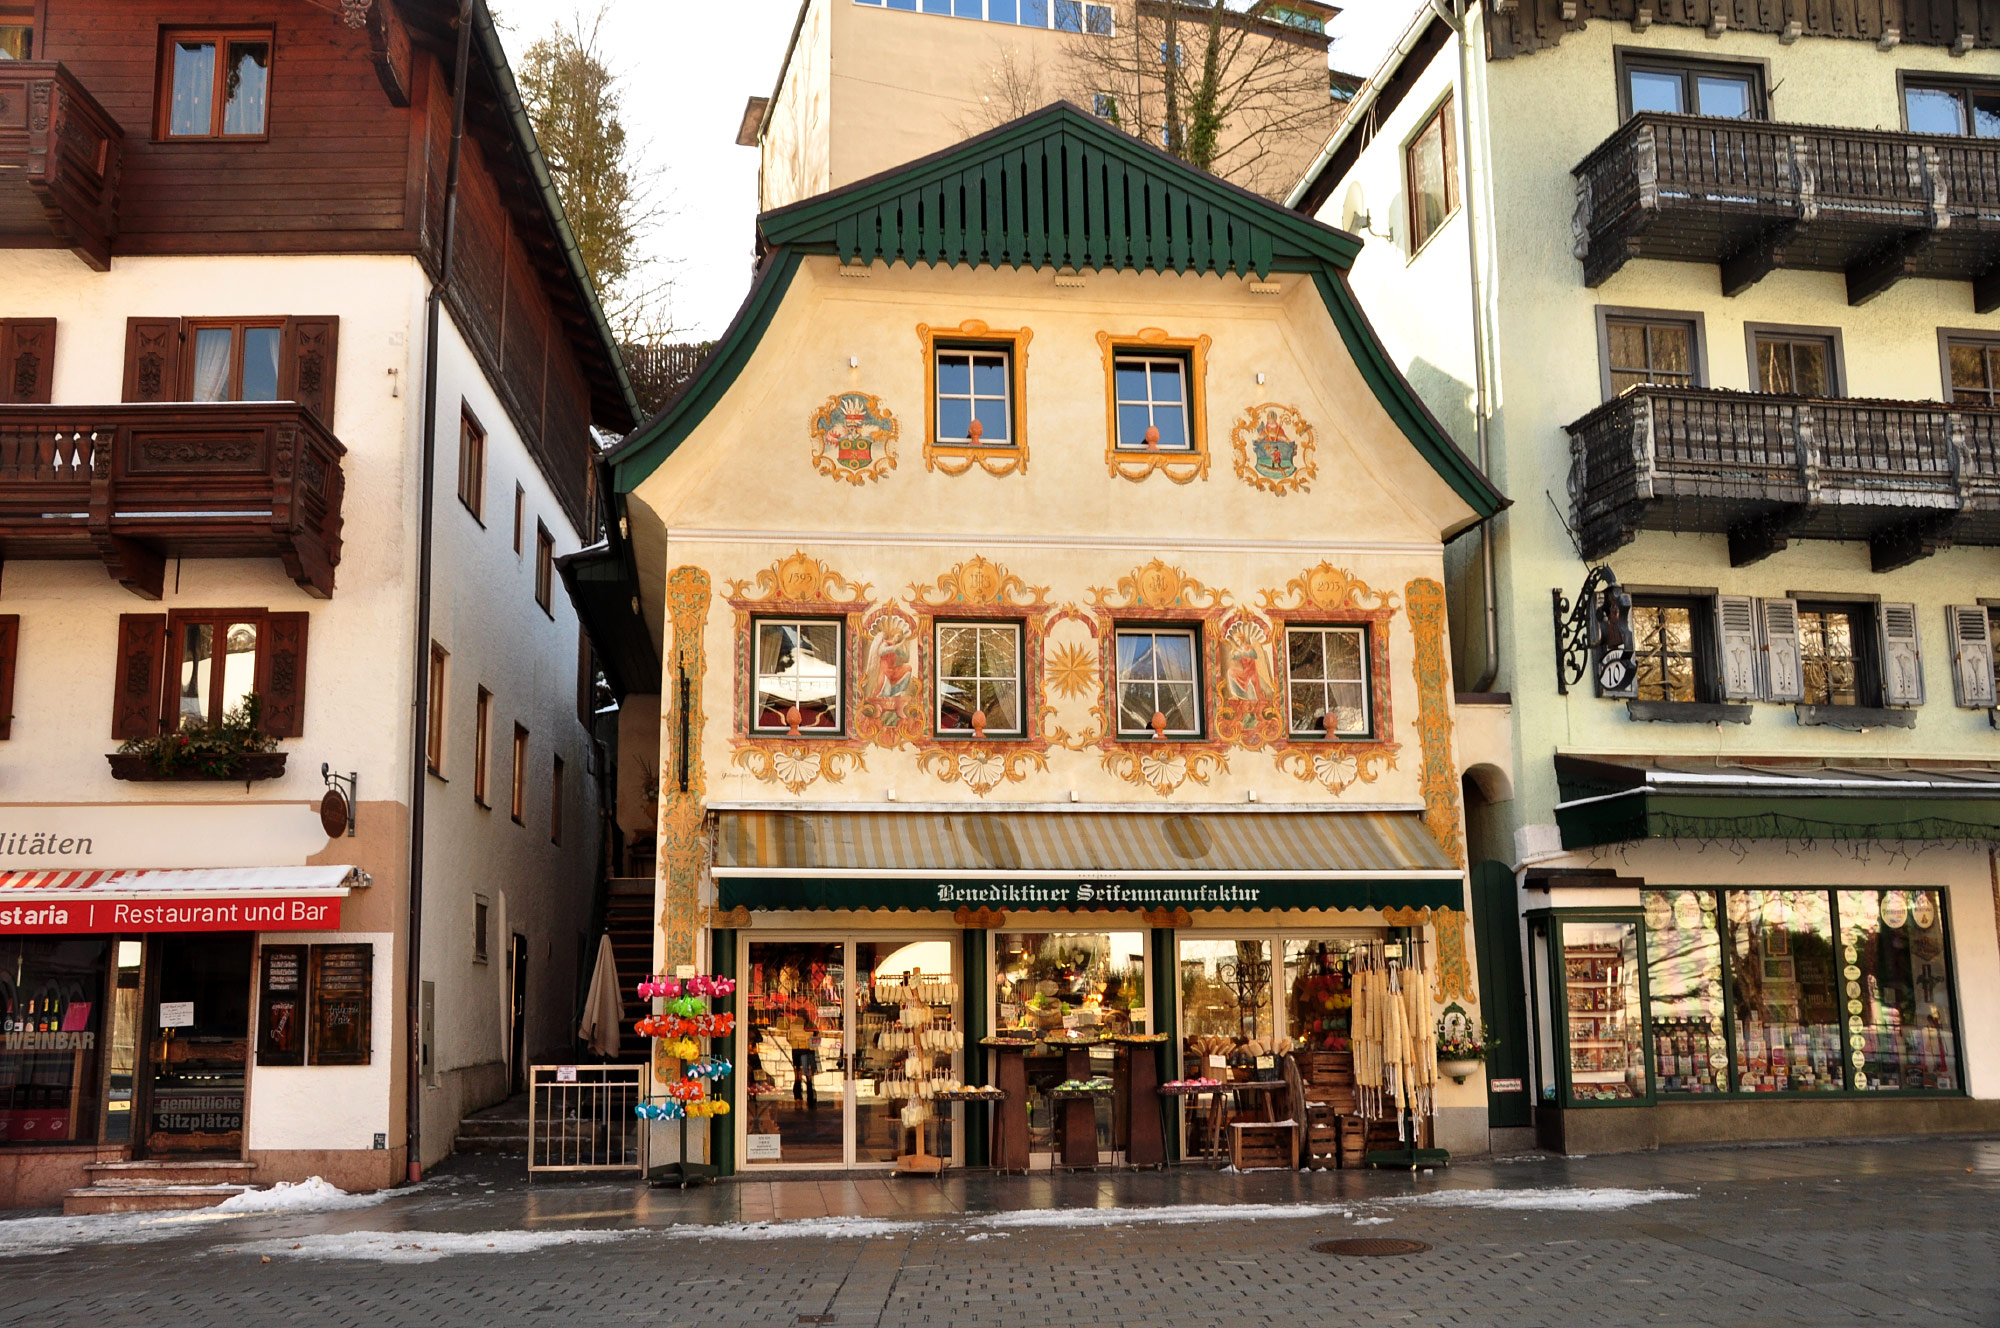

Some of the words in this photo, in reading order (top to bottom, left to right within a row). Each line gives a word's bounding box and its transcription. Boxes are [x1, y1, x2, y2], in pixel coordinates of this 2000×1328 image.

[1608, 664, 1621, 687] 10
[937, 884, 1070, 902] Benediktiner
[1076, 884, 1260, 902] Seifenmanufaktur
[114, 903, 239, 924] Restaurant
[244, 901, 285, 921] und
[291, 901, 329, 921] Bar
[5, 1031, 95, 1050] WEINBAR
[160, 1096, 241, 1112] gemütliche
[160, 1113, 240, 1130] Sitzplätze
